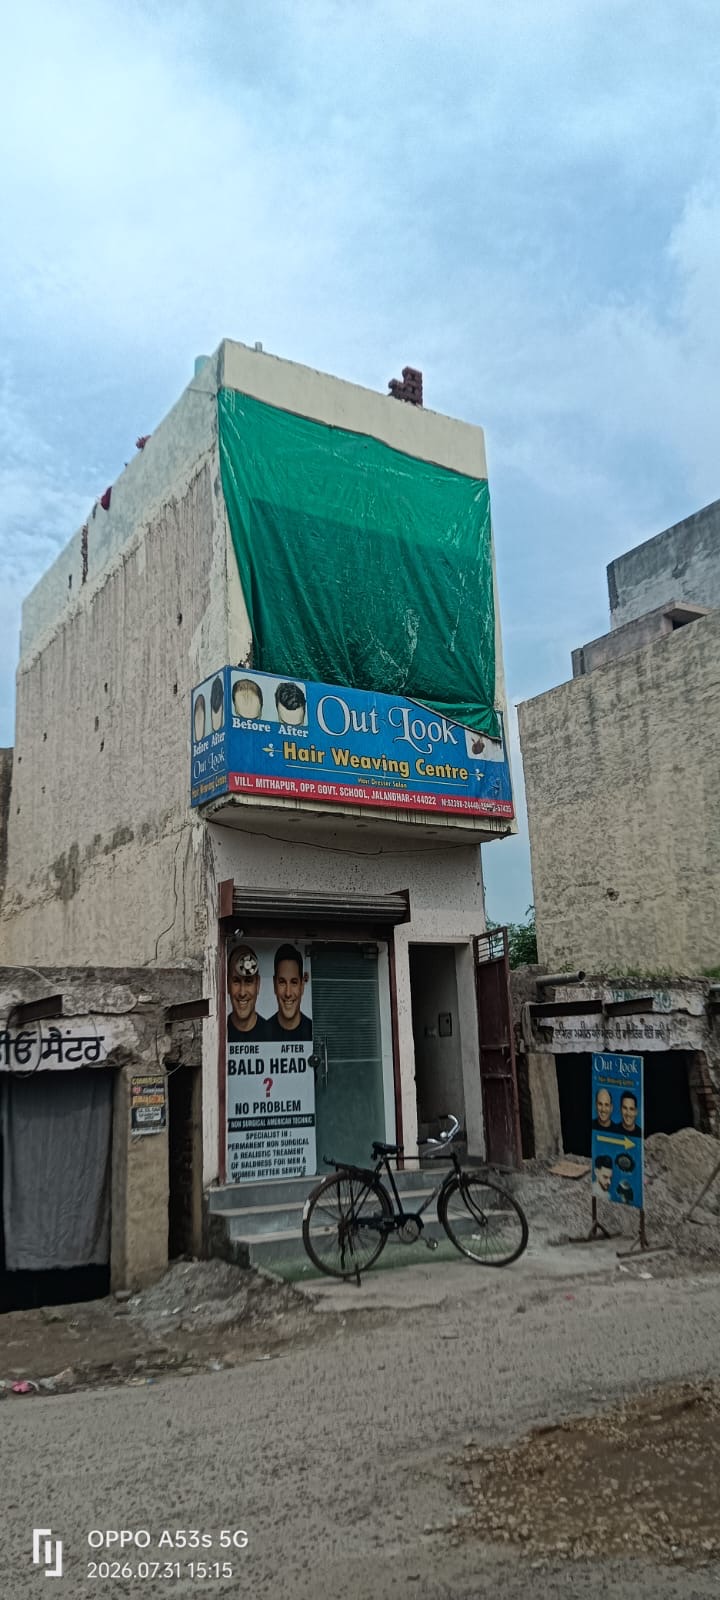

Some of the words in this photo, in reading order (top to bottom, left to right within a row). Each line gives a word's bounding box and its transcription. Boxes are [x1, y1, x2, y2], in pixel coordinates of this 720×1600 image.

[232, 717, 271, 732] Before
[278, 724, 309, 738] After
[316, 694, 380, 737] Out
[388, 706, 459, 754] Look
[193, 740, 209, 757] Before
[211, 731, 226, 747] After
[193, 760, 207, 779] Out
[208, 747, 225, 771] Look
[283, 741, 326, 764] Hair
[331, 747, 410, 778] Weaving
[415, 758, 469, 781] Centre
[234, 775, 253, 787] VILL.
[255, 777, 299, 793] MITHAPUR,
[300, 782, 316, 793] OPP.
[317, 784, 338, 795] GOVT.
[340, 786, 370, 799] SCHOOL,
[371, 789, 437, 806] JALANDHAR-144022
[392, 780, 408, 789] Salon
[41, 1026, 105, 1063] ਸੈਂਟਰ
[229, 1045, 260, 1055] BEFORE
[281, 1044, 304, 1053] AFTER
[228, 1058, 265, 1076] BALD
[270, 1057, 307, 1074] HEAD
[594, 1055, 613, 1073] Out
[615, 1057, 638, 1078] Look
[263, 1077, 274, 1098] ?
[235, 1102, 249, 1115] NO
[253, 1099, 301, 1114] PROBLEM
[230, 1120, 242, 1129] NON
[242, 1118, 266, 1128] SURGICAL
[266, 1117, 291, 1127] AMERICAN
[245, 1130, 280, 1140] SPECIALIST
[228, 1141, 265, 1152] PERMANENT
[266, 1140, 279, 1149] NON
[281, 1138, 309, 1148] SURGICAL
[240, 1150, 271, 1159] REALISTIC
[231, 1161, 239, 1170] OF
[241, 1159, 272, 1169] BALDNESS
[273, 1158, 286, 1167] FOR
[287, 1157, 300, 1165] MEN
[231, 1170, 256, 1180] WOMEN
[257, 1168, 280, 1177] BETTER
[281, 1165, 307, 1175] SERVICE
